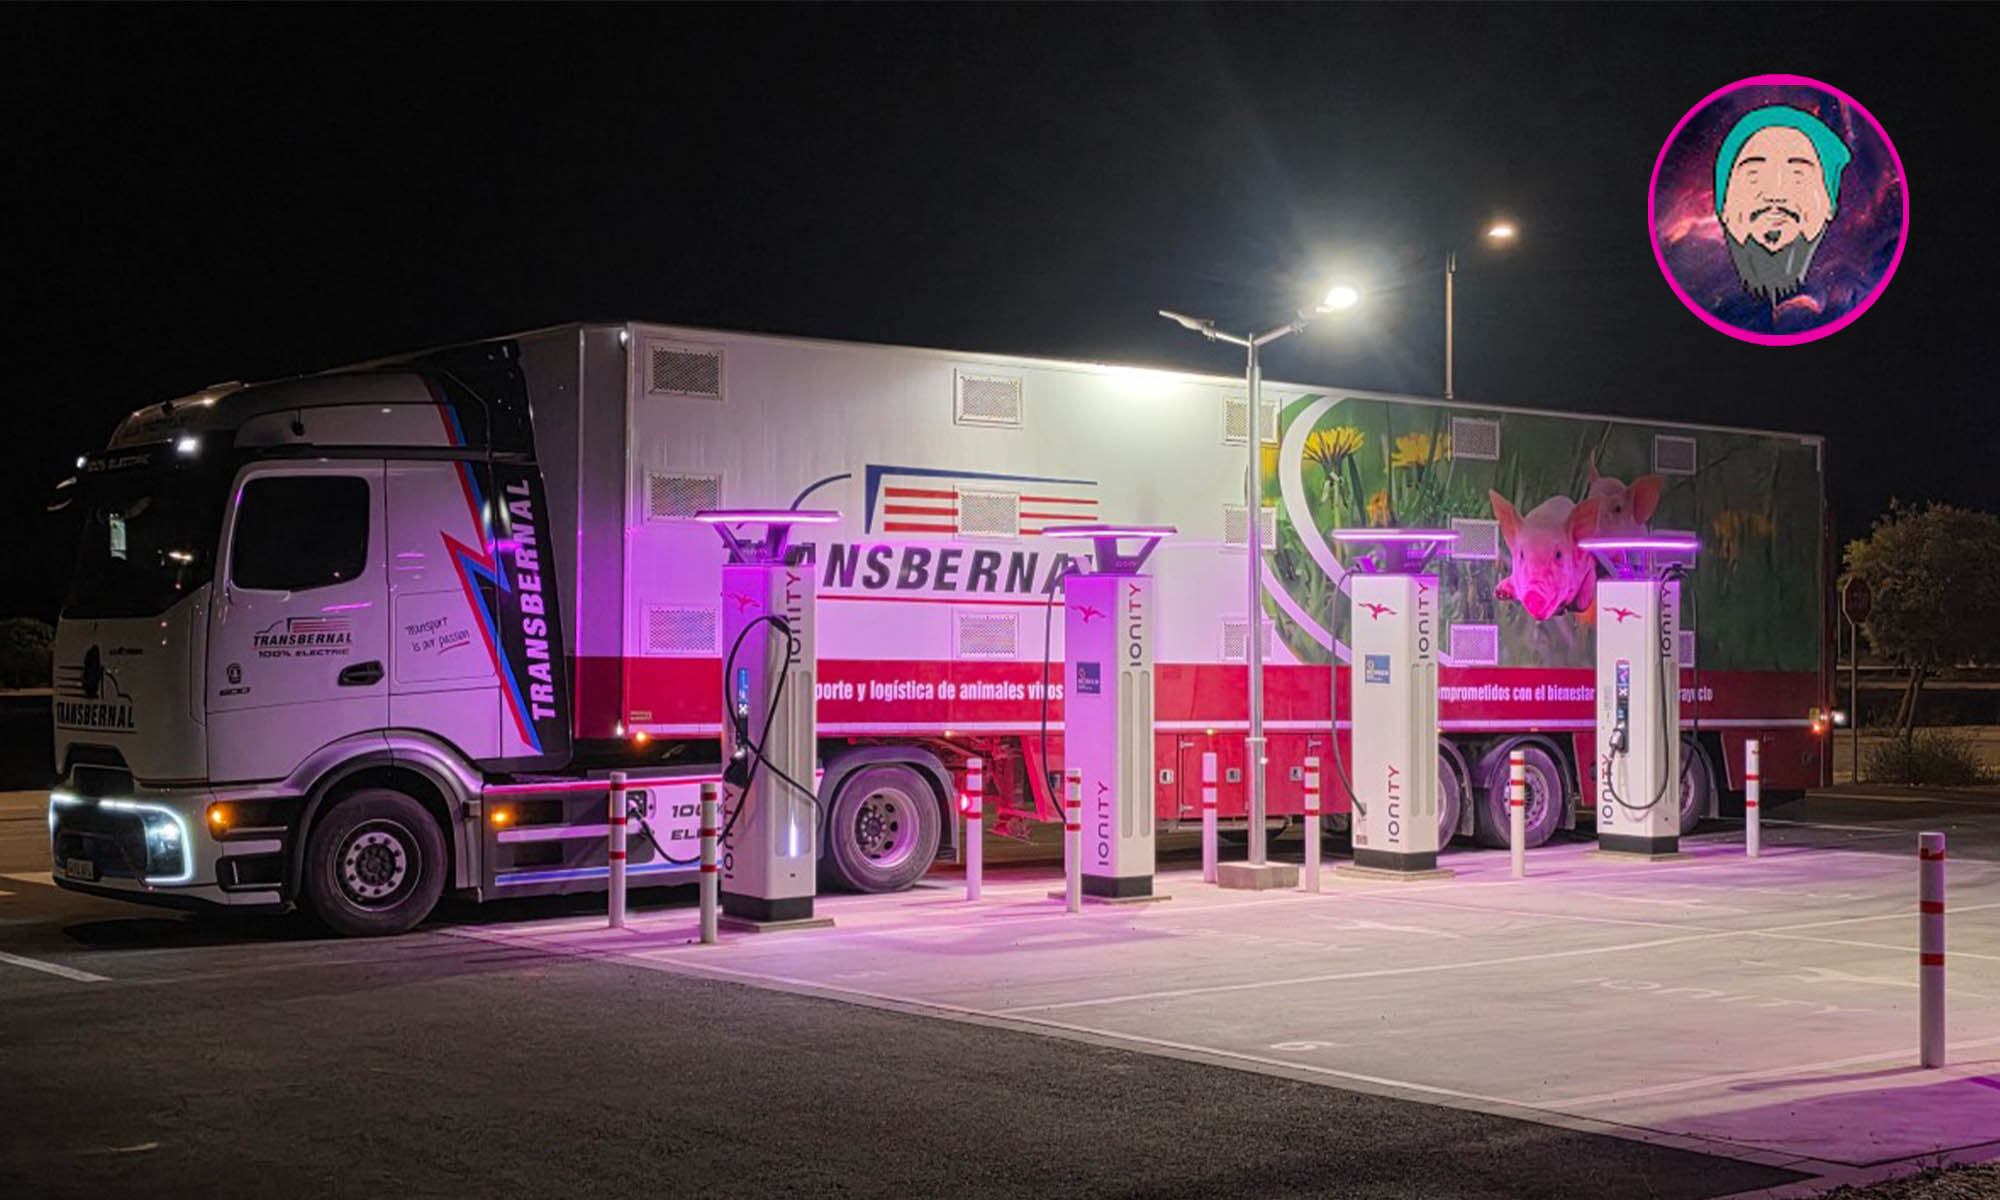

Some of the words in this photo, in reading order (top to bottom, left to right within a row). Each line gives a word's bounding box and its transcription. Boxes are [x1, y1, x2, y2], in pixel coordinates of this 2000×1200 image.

[506, 479, 556, 721] TRANSBERNAL
[724, 540, 1093, 594] NSBERNA
[253, 632, 353, 647] TRANSBERNAL
[1129, 583, 1142, 667] IONITY
[1418, 582, 1430, 660] IONITY
[816, 680, 853, 701] porte
[857, 683, 866, 702] y
[870, 680, 934, 702] logística
[938, 681, 955, 700] de
[960, 680, 1024, 701] animales
[1437, 684, 1510, 703] mprometidos
[1513, 686, 1533, 701] con
[1098, 782, 1109, 866] IONITY
[1388, 765, 1400, 843] IONITY
